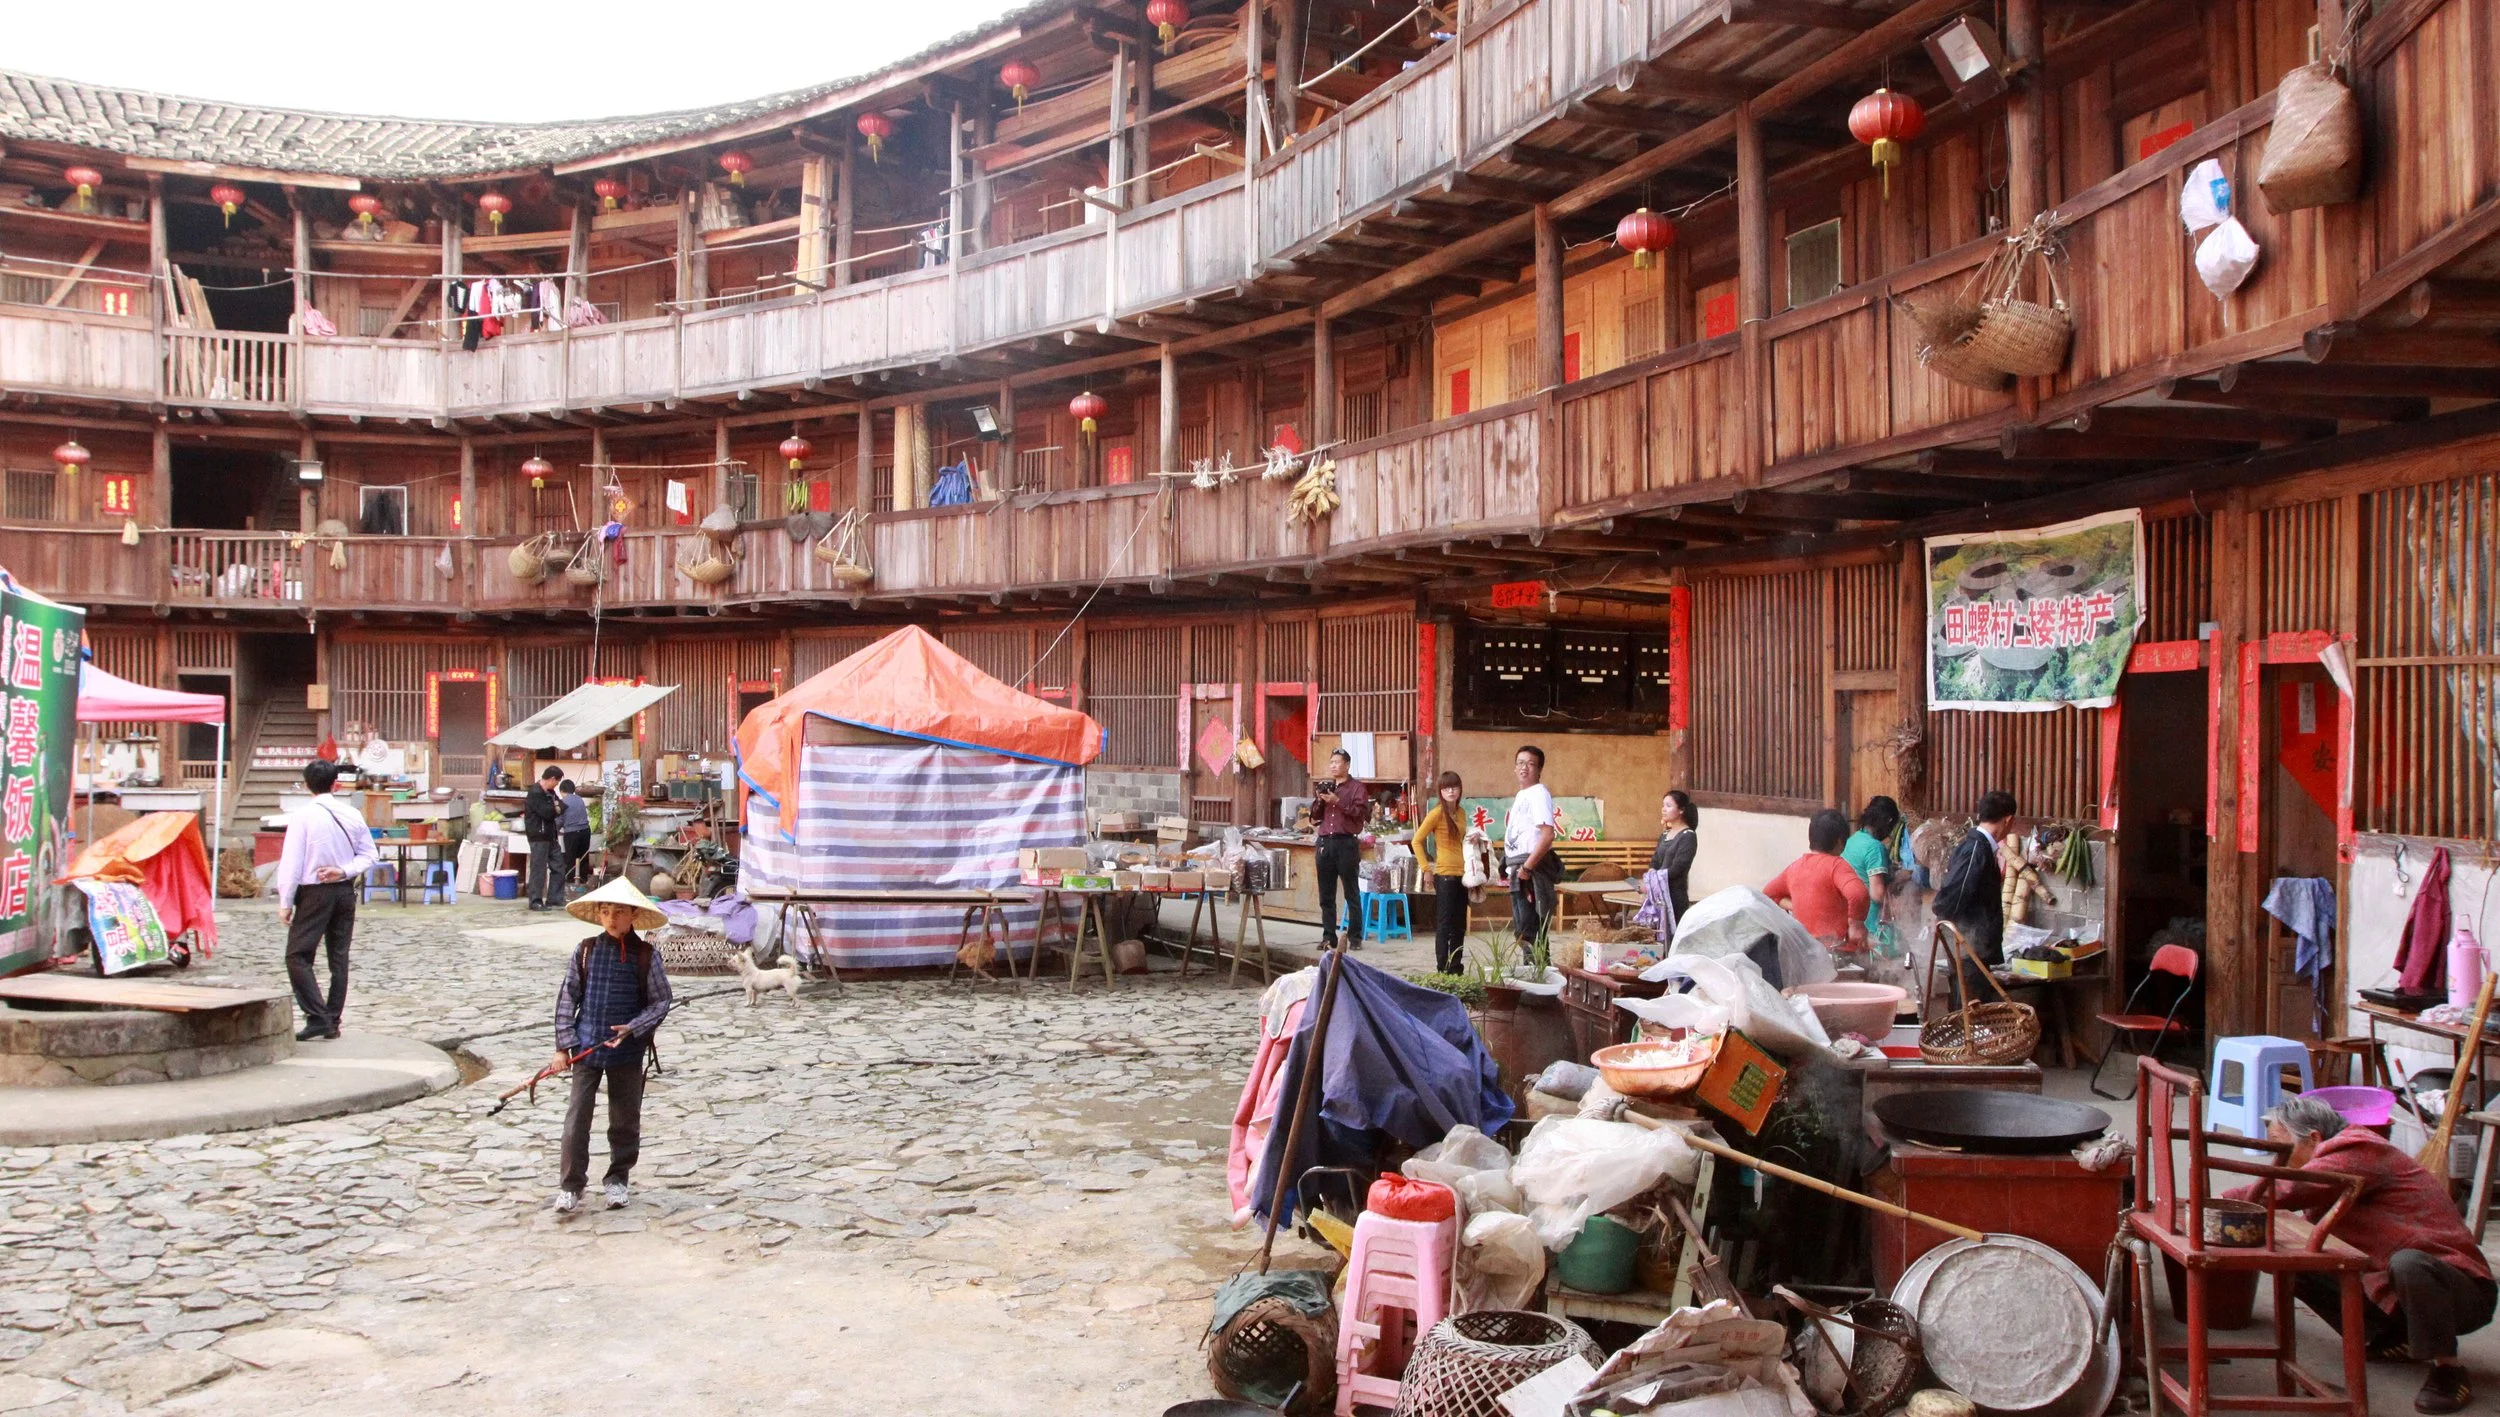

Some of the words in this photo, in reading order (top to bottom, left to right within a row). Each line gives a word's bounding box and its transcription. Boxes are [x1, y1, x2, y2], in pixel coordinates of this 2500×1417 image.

[1945, 589, 2115, 649] 田螺村土楼特产
[0, 619, 43, 921] 温馨饭店
